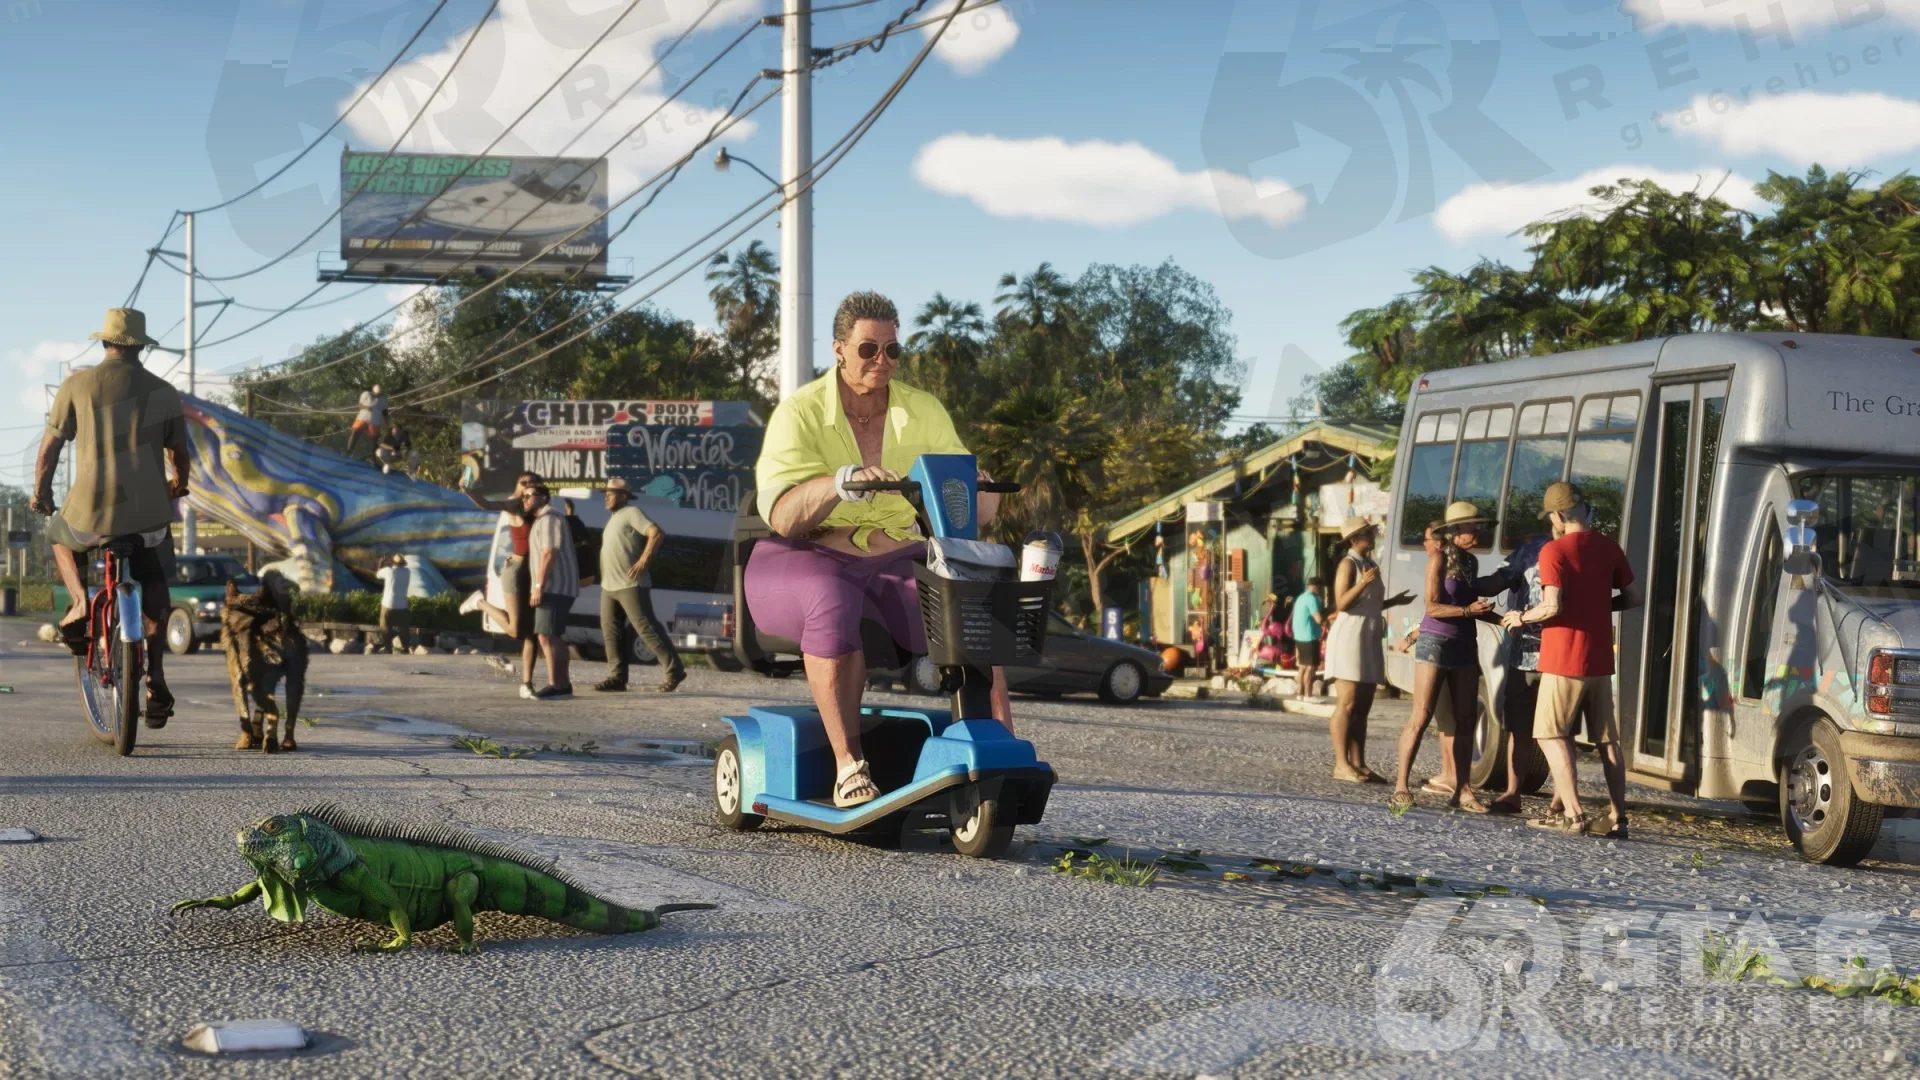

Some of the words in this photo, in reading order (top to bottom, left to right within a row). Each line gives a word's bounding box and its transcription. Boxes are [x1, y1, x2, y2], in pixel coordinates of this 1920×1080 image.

[348, 155, 409, 174] KEEPS
[654, 403, 700, 414] BODY
[1827, 391, 1875, 413] The
[527, 401, 648, 426] CHIP'S
[654, 415, 700, 426] SHOP
[523, 450, 581, 479] HAVING
[585, 450, 596, 479] A
